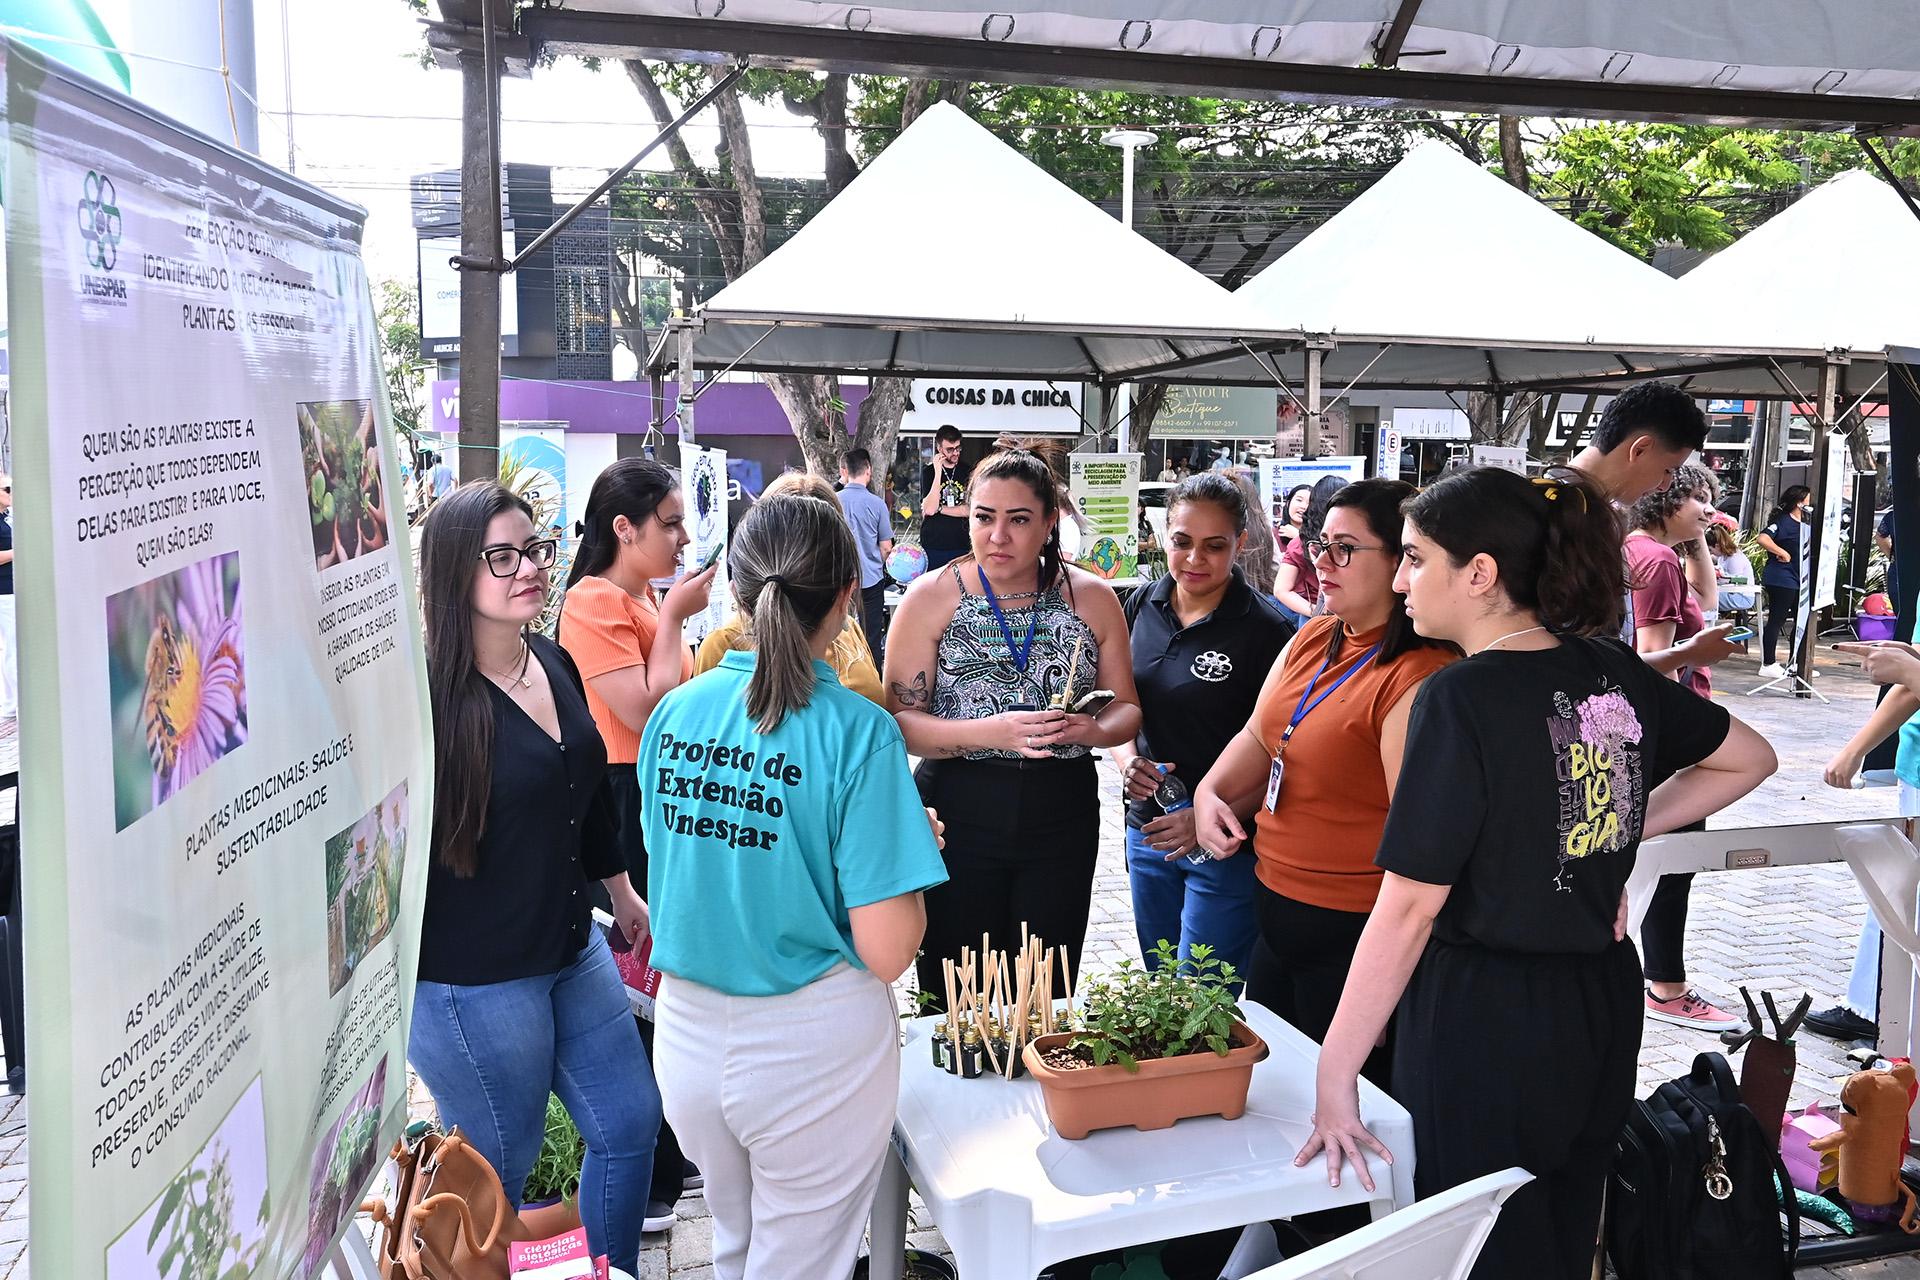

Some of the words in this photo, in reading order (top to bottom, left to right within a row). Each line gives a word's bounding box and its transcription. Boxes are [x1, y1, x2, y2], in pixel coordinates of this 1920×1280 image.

[80, 274, 127, 299] UNESPAR
[143, 253, 229, 291] IDENTIFICANDO
[437, 290, 460, 299] COMER
[183, 304, 236, 331] PLANTAS
[441, 387, 459, 419] vi
[925, 387, 986, 405] COISAS
[992, 388, 1016, 406] DA
[1021, 390, 1072, 407] CHICA
[82, 431, 119, 462] QUEM
[120, 423, 141, 452] SÃO
[143, 427, 156, 449] AS
[158, 422, 203, 447] PLANTAS?
[205, 420, 242, 440] EXISTE
[246, 418, 255, 437] A
[79, 462, 144, 500] PERCEPÇÃO
[146, 463, 165, 490] QUE
[167, 458, 198, 481] TODOS
[200, 450, 261, 476] DEPENDEM
[78, 511, 118, 542] DELAS
[120, 504, 148, 531] PARA
[149, 495, 188, 523] EXISTIR?
[191, 492, 198, 511] E
[200, 486, 227, 509] PARA
[136, 536, 165, 568] QUEM
[167, 526, 186, 554] SÃO
[188, 522, 213, 547] ELAS?
[318, 612, 336, 636] NOSSO
[337, 596, 373, 624] COTIDIANO
[374, 588, 388, 607] PODE
[388, 583, 399, 600] SER
[320, 580, 343, 605] INSERIR
[344, 576, 354, 593] AS
[355, 565, 381, 590] PLANTAS
[327, 643, 332, 660] A
[332, 626, 365, 656] GARANTIA
[365, 621, 374, 638] DE
[375, 610, 393, 633] SAÚDE
[392, 608, 397, 623] E
[335, 649, 371, 684] QUALIDADE
[371, 643, 381, 661] DE
[658, 733, 756, 772] Projeto
[763, 752, 803, 786] de
[1569, 741, 1612, 781] BIO
[185, 804, 231, 861] PLANTAS
[233, 760, 309, 820] MEDICINAIS:
[312, 739, 348, 774] SAÚDE
[348, 733, 353, 752] E
[656, 767, 784, 818] Extensão
[1585, 771, 1611, 821] LO
[216, 785, 328, 876] SUSTENTABILIDADE
[1567, 812, 1619, 858] GIA
[125, 1002, 143, 1034] AS
[147, 954, 192, 1015] PLANTAS
[193, 902, 245, 967] MEDICINAIS
[100, 997, 185, 1089] CONTRIBUEM
[186, 971, 209, 1009] COM
[210, 962, 218, 984] A
[219, 931, 246, 973] SAÚDE
[248, 917, 262, 942] DE
[325, 1032, 335, 1056] AS
[360, 984, 369, 1004] DE
[95, 1070, 147, 1128] TODOS
[150, 1051, 167, 1081] OS
[169, 1016, 200, 1063] SERES
[231, 946, 266, 992] UTILIZE,
[91, 1087, 168, 1169] PRESERVE,
[172, 1031, 215, 1095] RESPEITE
[216, 1022, 222, 1042] E
[224, 970, 270, 1033] DISSEMINE
[132, 1146, 142, 1169] O
[146, 1079, 204, 1155] CONSUMO
[206, 1025, 251, 1089] RACIONAL.
